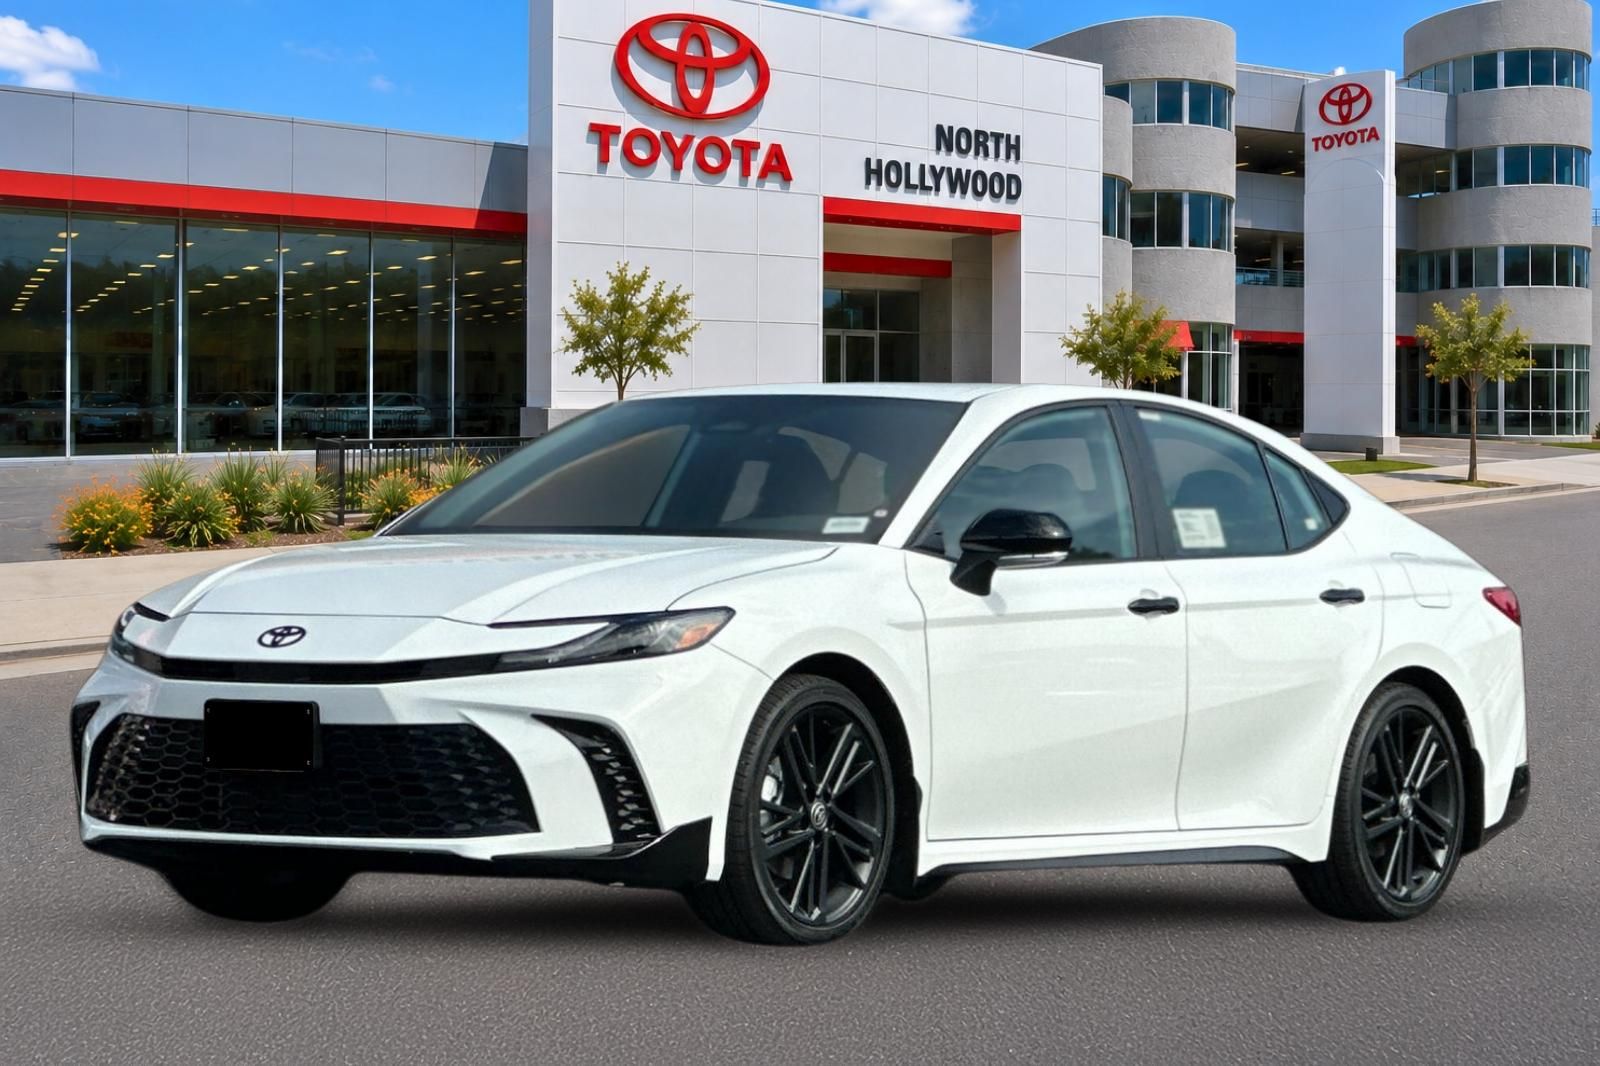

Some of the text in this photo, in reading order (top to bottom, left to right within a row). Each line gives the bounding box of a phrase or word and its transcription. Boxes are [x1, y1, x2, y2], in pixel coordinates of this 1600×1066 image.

[588, 122, 793, 183] TOYOTA
[936, 124, 1021, 162] NORTH
[1312, 126, 1380, 152] TOYOTA
[865, 157, 1022, 200] HOLLYWOOD
